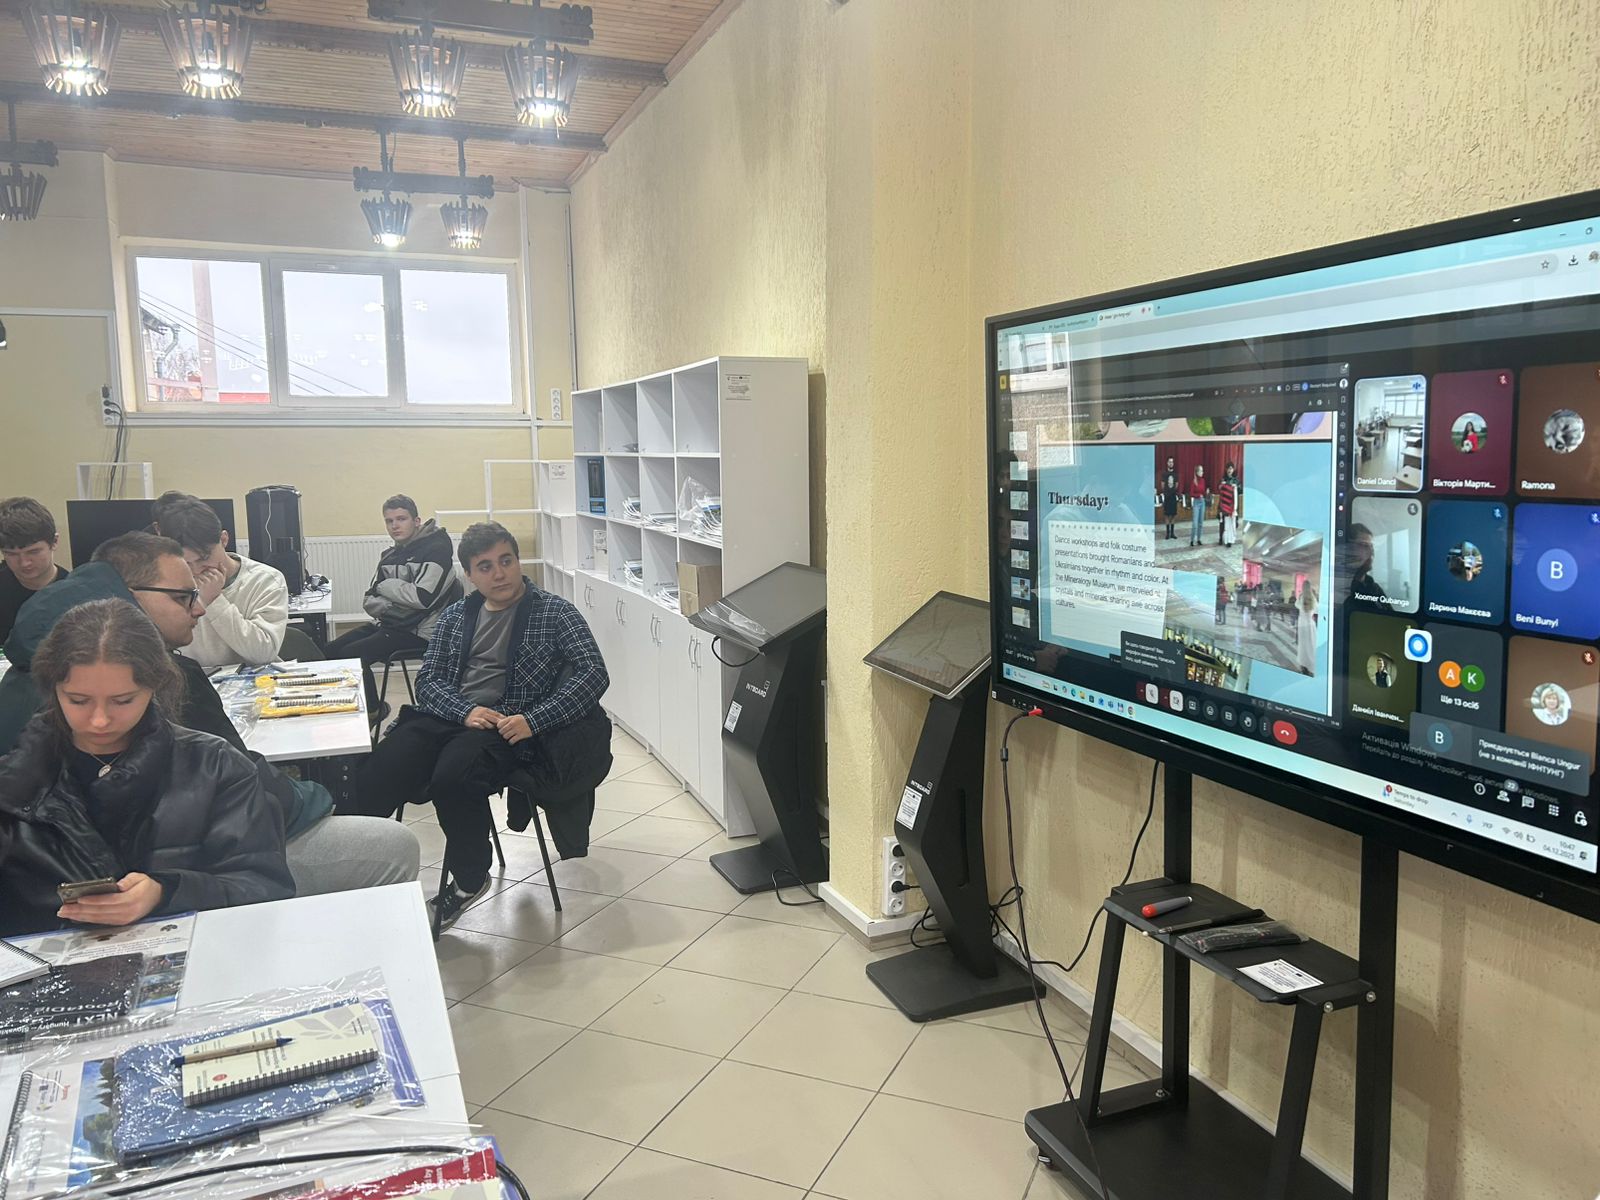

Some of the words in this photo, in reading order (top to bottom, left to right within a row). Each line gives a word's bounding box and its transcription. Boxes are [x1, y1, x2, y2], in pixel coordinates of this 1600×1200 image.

[1521, 480, 1556, 490] Ramona
[1048, 492, 1109, 510] Thursday:
[1055, 535, 1070, 544] Dance
[1071, 538, 1098, 548] workshops
[1122, 544, 1147, 553] costume
[1055, 549, 1088, 559] presentations
[1089, 553, 1109, 563] brought
[1111, 554, 1142, 567] Romanians
[1082, 564, 1103, 575] together
[1111, 568, 1130, 579] rhythm
[1132, 571, 1142, 580] and
[1550, 560, 1563, 579] B
[1064, 574, 1091, 587] Mineralogy
[1110, 594, 1130, 608] sharing
[1144, 602, 1164, 612] across
[1355, 592, 1379, 602] Xoomer
[1380, 596, 1410, 607] Qubanga
[1429, 602, 1457, 613] Дарина
[1516, 613, 1534, 624] Beni
[1440, 694, 1453, 704] Ще
[1463, 699, 1479, 710] осіб
[1435, 730, 1444, 744] B
[1362, 731, 1399, 748] Активація
[1401, 741, 1437, 759] Windows
[1479, 739, 1529, 758] Приєднується
[1531, 752, 1555, 764] Bianca
[1557, 758, 1580, 771] Ungur
[37, 1021, 70, 1032] Hungary
[73, 1012, 118, 1027] NEXT
[0, 1026, 30, 1036] Slovaki
